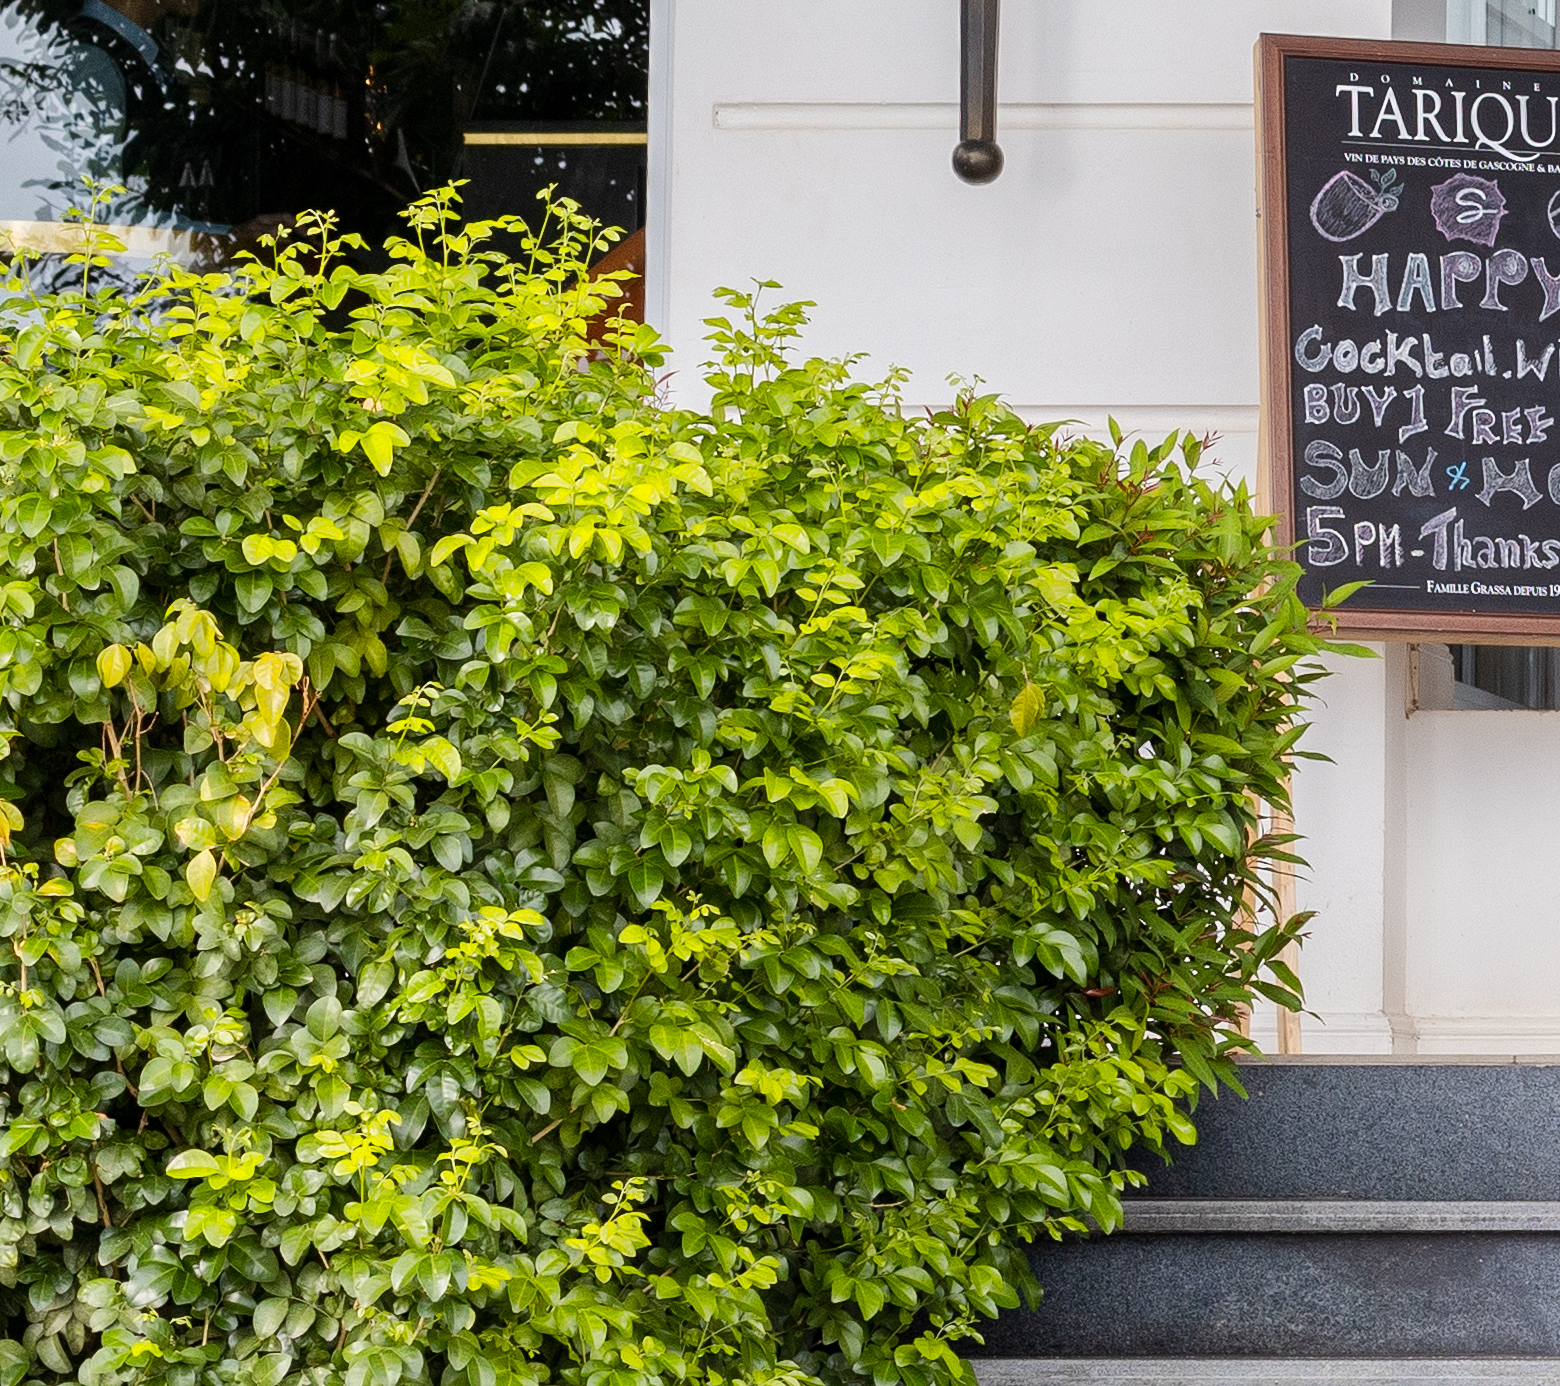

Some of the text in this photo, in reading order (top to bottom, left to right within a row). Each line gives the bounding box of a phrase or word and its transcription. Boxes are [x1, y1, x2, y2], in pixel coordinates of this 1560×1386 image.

[1349, 72, 1542, 93] DOMAINE
[1343, 152, 1363, 163] VIN
[1365, 153, 1380, 164] DE
[1380, 154, 1406, 165] PAYS
[1406, 155, 1427, 167] DES
[1427, 156, 1462, 169] CÔTES
[1463, 159, 1478, 170] DE
[1478, 160, 1536, 173] GASCOGNE
[1536, 164, 1547, 173] &
[1303, 382, 1398, 427] BUY
[1300, 439, 1439, 500] SUN
